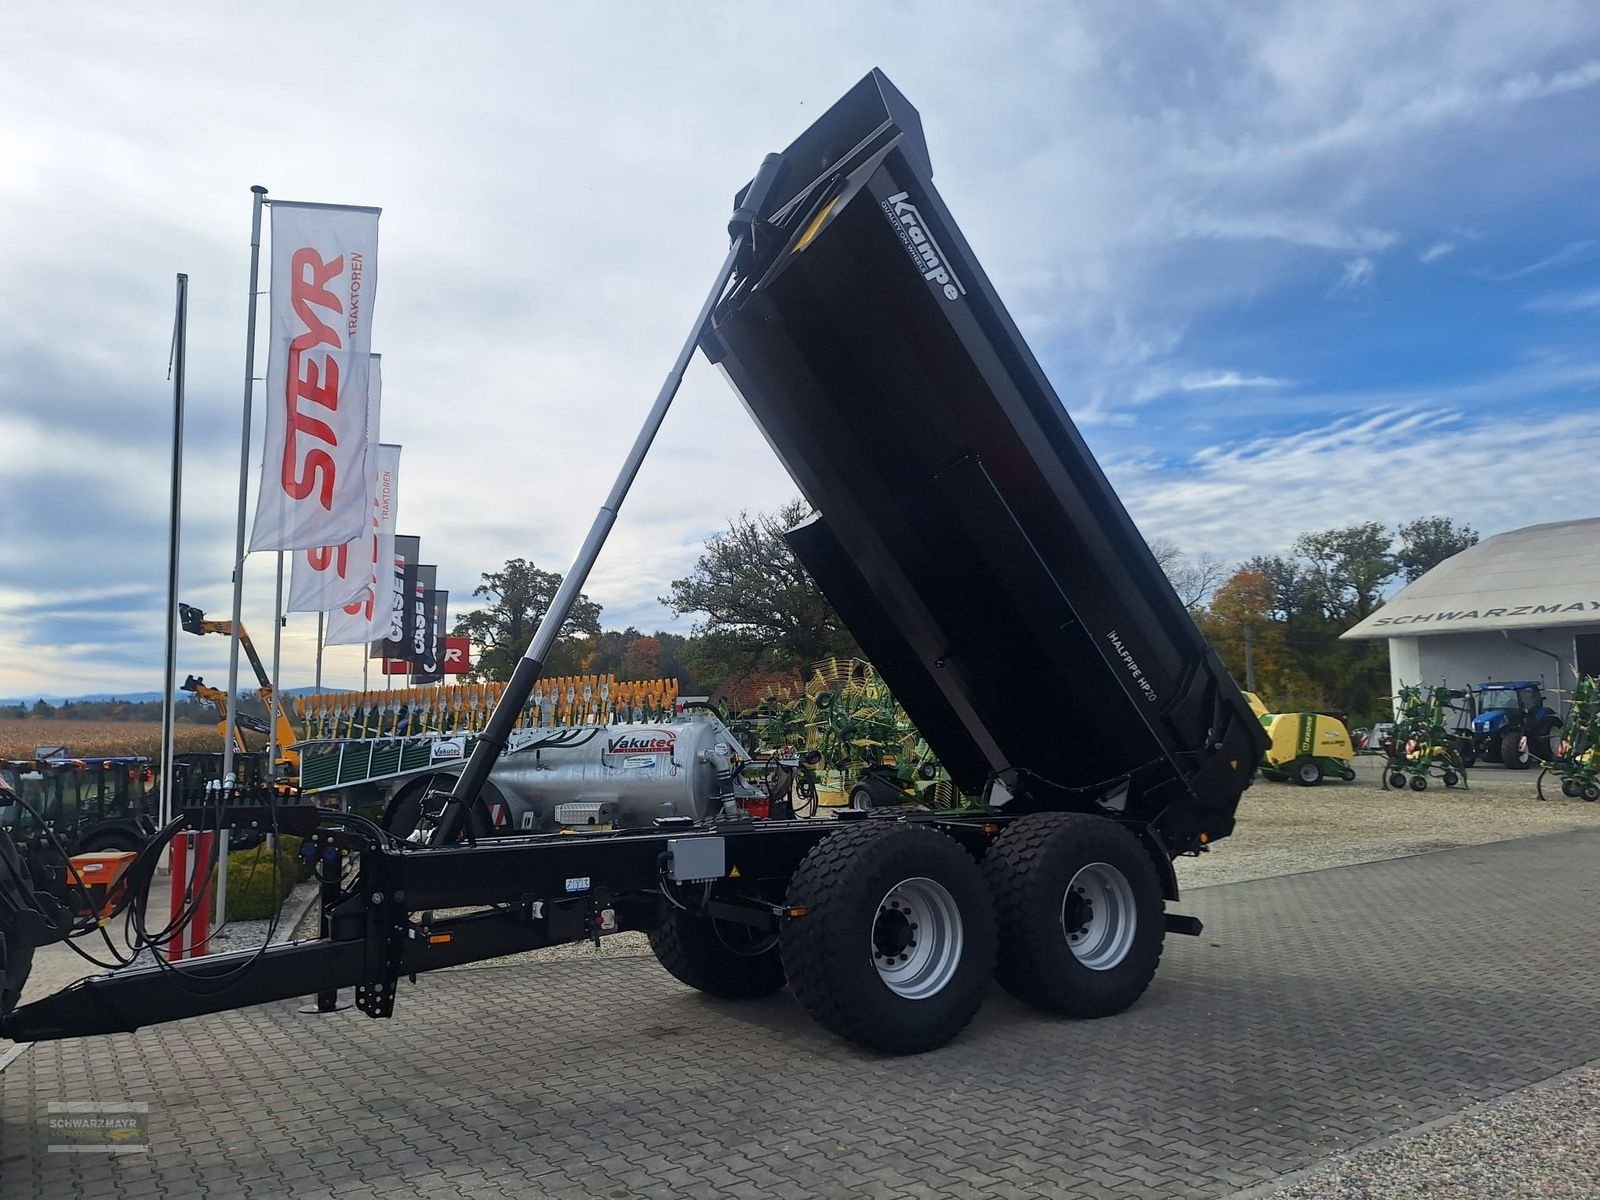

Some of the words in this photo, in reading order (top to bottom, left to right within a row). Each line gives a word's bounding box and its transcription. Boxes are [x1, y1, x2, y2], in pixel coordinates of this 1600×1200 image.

[881, 200, 900, 231] QUALITY
[900, 231, 909, 244] ON
[907, 244, 927, 273] WHEELS
[888, 191, 965, 300] Krampe
[348, 252, 363, 338] TRAKTOREN
[281, 247, 344, 512] STEYR
[381, 471, 392, 520] TRAKTOREN
[1108, 632, 1141, 677] HALFPIPE
[1138, 678, 1157, 701] HP20
[434, 747, 460, 756] Vakutec
[608, 735, 676, 753] Vakutec
